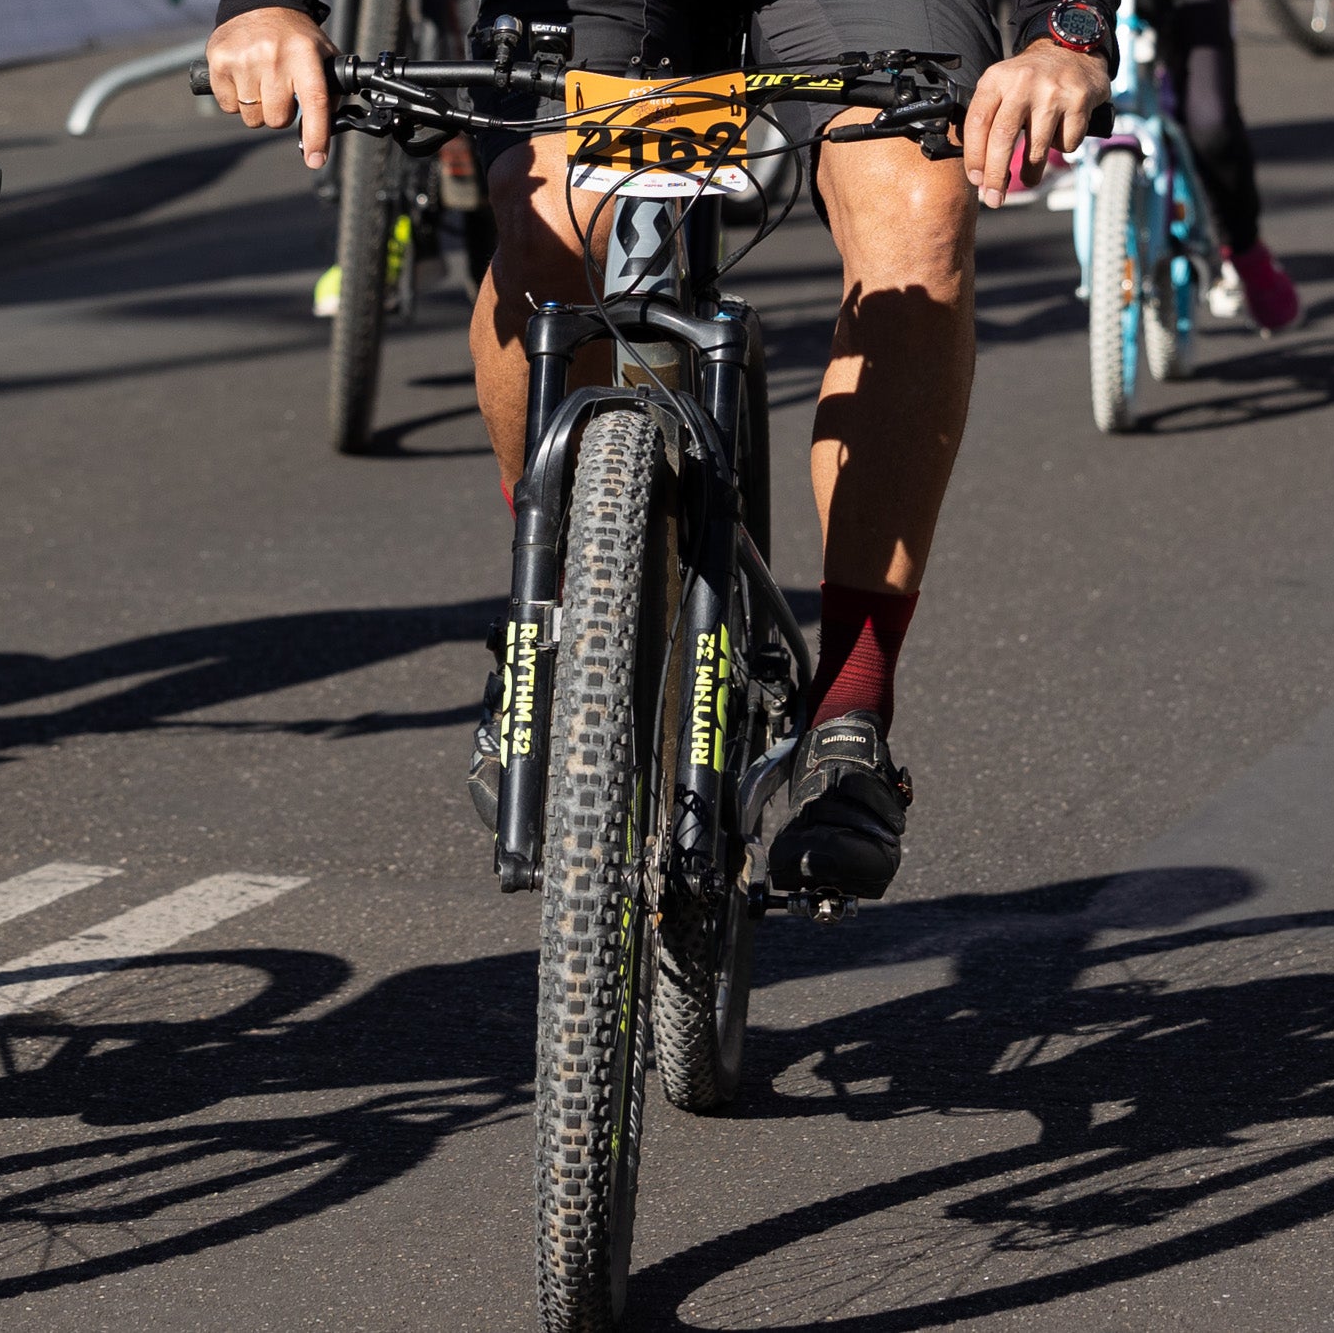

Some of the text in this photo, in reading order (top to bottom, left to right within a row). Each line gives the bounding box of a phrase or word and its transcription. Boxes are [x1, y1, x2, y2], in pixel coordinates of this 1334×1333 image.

[531, 23, 568, 34] CATEYE
[575, 120, 741, 173] 2162
[511, 623, 539, 757] RHYTHM 32
[690, 632, 717, 766] RHYTHM 32
[820, 733, 867, 746] SHIMANO
